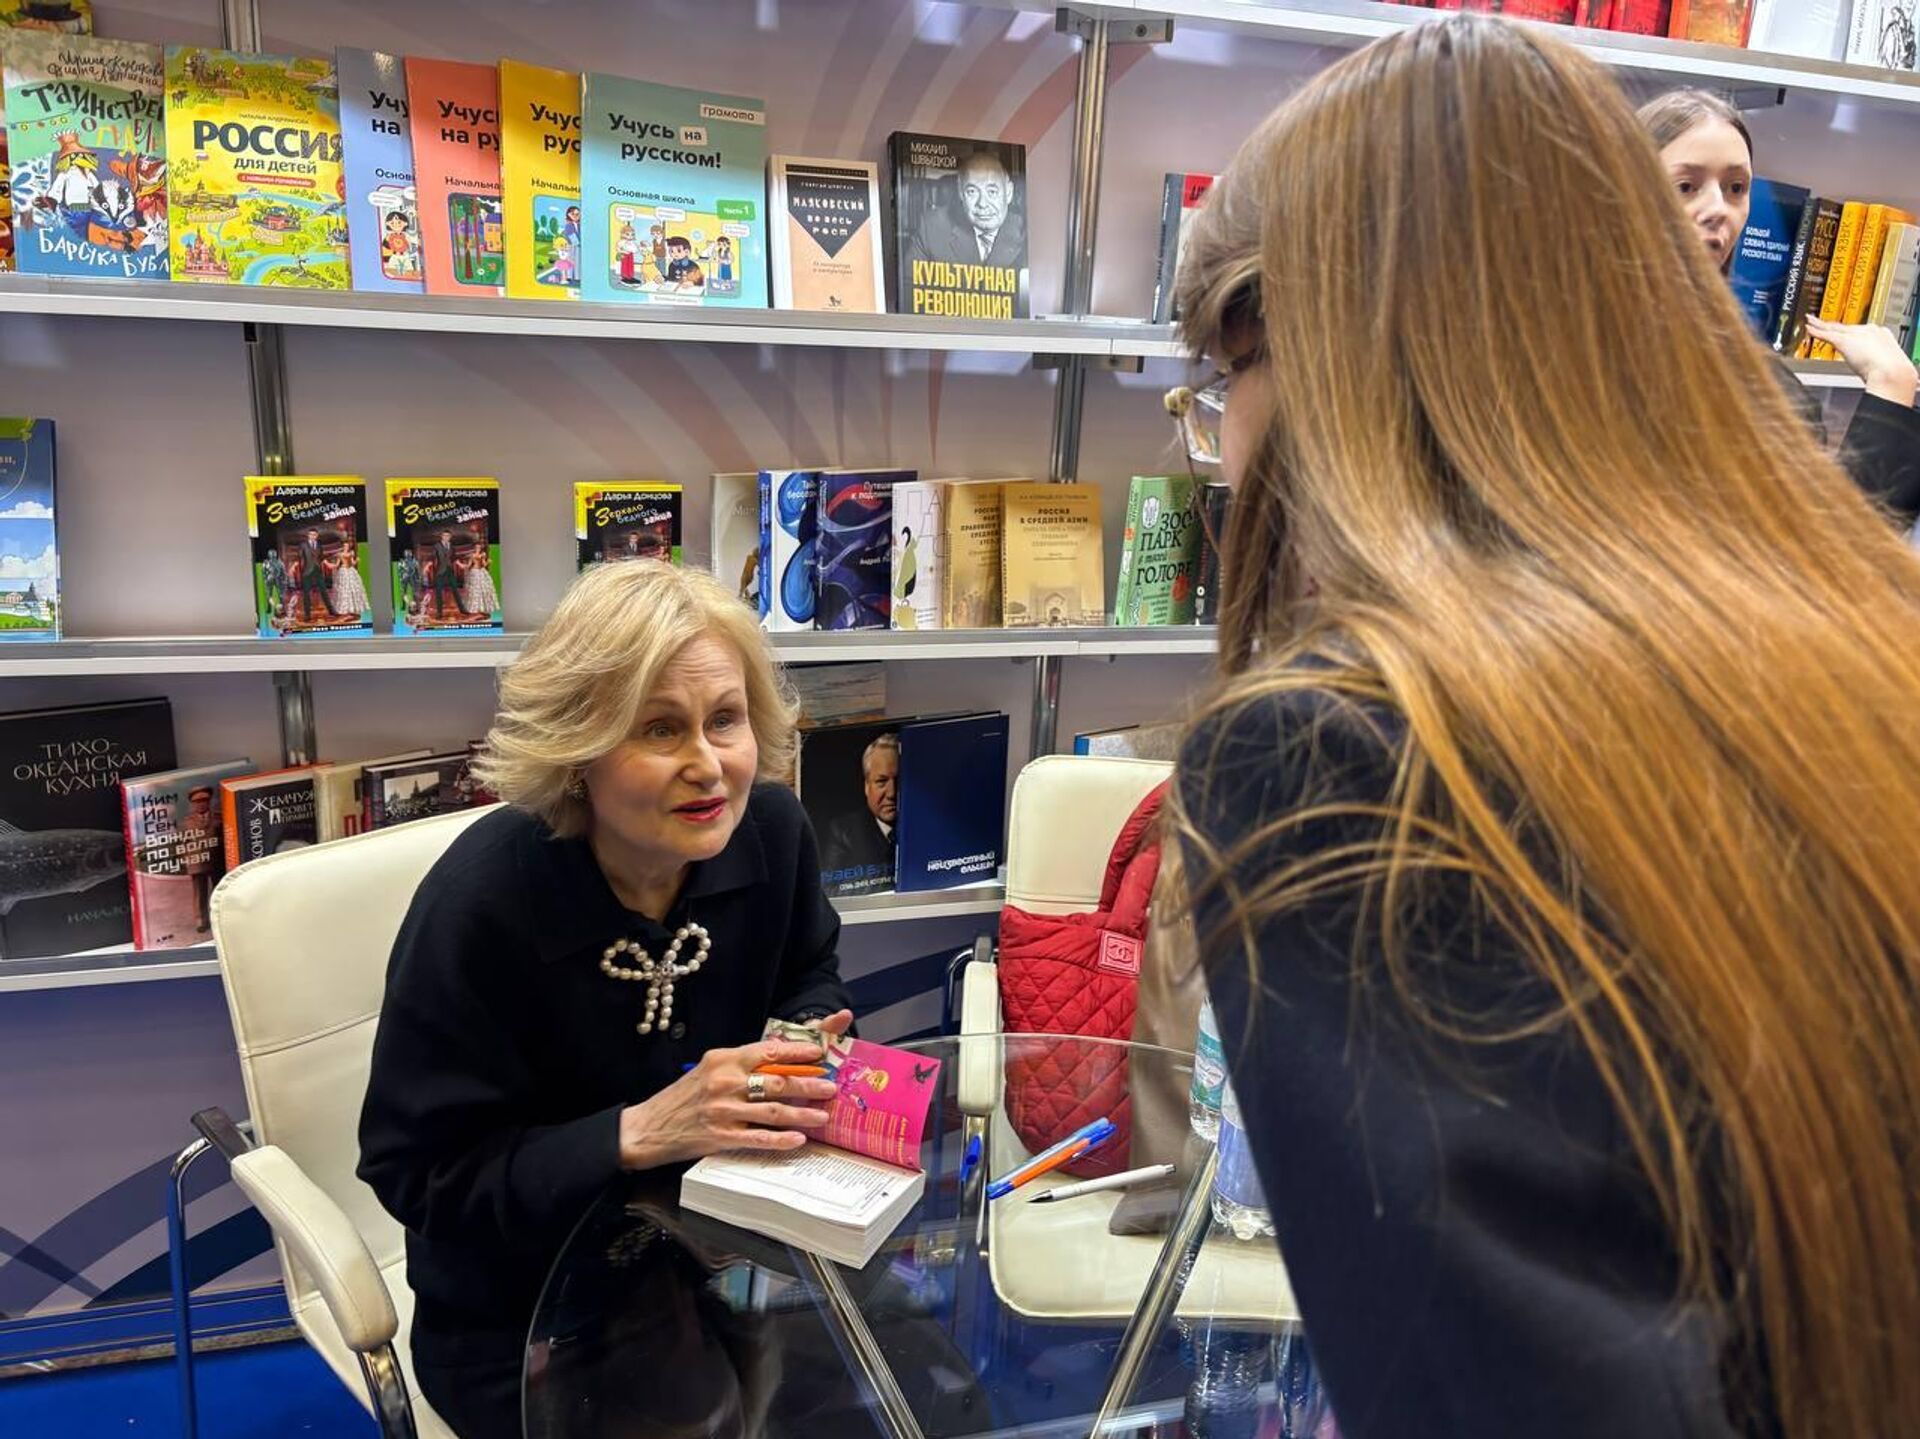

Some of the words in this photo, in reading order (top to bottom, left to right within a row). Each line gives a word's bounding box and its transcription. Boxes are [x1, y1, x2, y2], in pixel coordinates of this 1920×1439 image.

[372, 119, 400, 135] на
[441, 128, 469, 143] на
[608, 113, 675, 138] Учусь
[684, 131, 702, 141] на
[621, 143, 721, 168] русском!
[910, 142, 947, 155] МИХАИЛ
[234, 157, 265, 170] для
[268, 160, 317, 175] детей
[911, 154, 956, 168] ШВЫДКОЙ
[608, 186, 660, 200] Основная
[662, 194, 695, 205] школа
[793, 197, 865, 211] МАЯКОВСКИЙ
[39, 227, 118, 266] БАРСУКА
[912, 259, 1016, 293] КУЛЬТУРНАЯ
[1782, 267, 1800, 311] РУССКИЙ
[913, 289, 1013, 320] РЕВОЛЮЦИЯ
[276, 486, 308, 496] Дарья
[310, 486, 355, 496] Донцова
[413, 489, 442, 499] Дарья
[445, 489, 488, 498] Донцова
[266, 498, 322, 523] Зеркало
[403, 501, 456, 525] Зеркало
[1139, 529, 1183, 551] ПАРК
[40, 737, 120, 759] ТИХО-
[13, 751, 147, 781] ОКЕАНСКАЯ
[45, 771, 121, 796] КУХНЯ
[141, 792, 178, 807] Ким
[143, 807, 168, 821] Ир
[144, 820, 177, 834] Сен
[145, 828, 206, 848] Вождь
[146, 847, 170, 861] по
[175, 836, 218, 855] воле
[148, 851, 210, 874] случая
[927, 851, 995, 871] неизвестный
